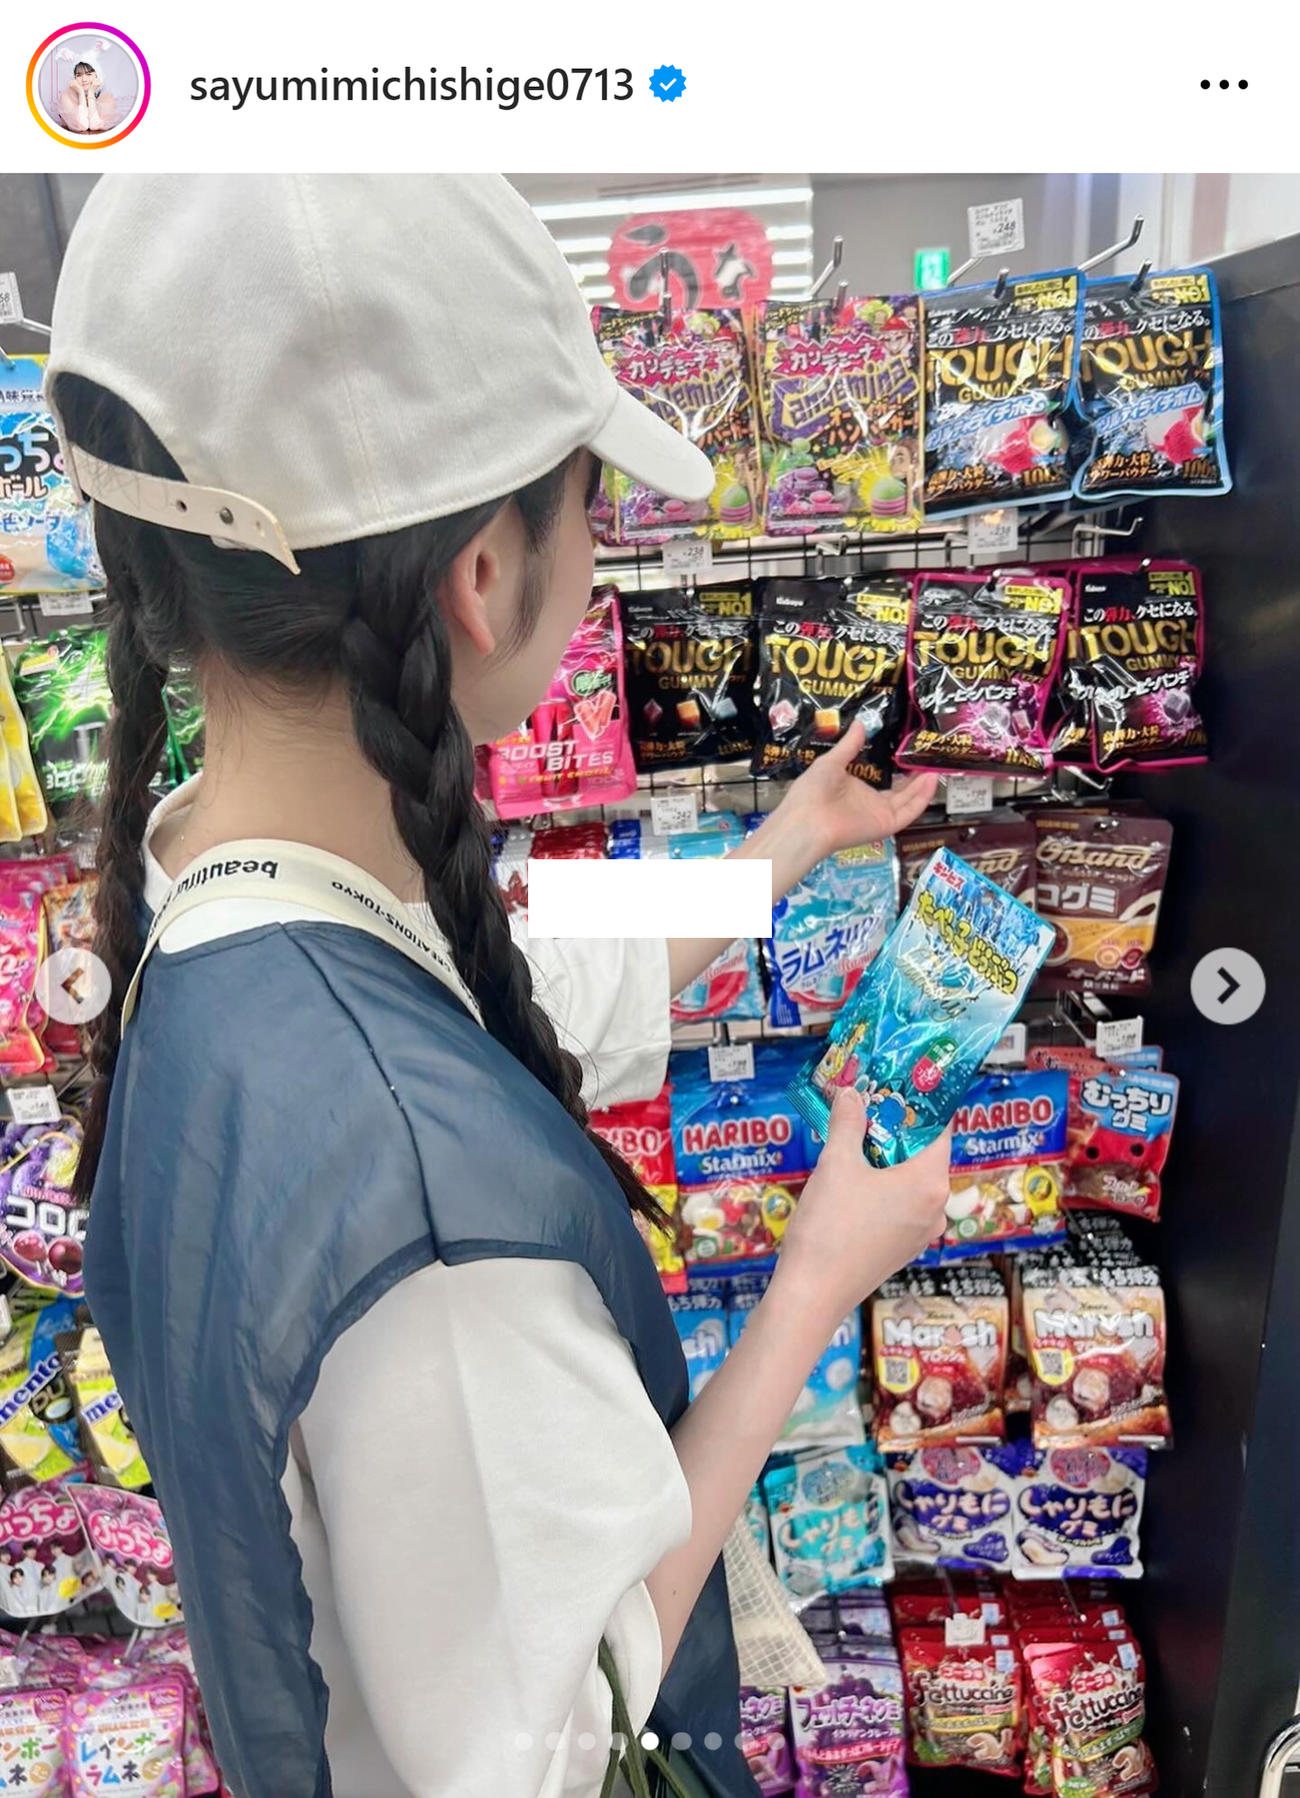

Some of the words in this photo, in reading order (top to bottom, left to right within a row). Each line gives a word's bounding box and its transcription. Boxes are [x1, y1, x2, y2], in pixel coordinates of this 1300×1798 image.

[1081, 329, 1213, 382] TOUGH
[764, 633, 906, 684] TOUGH
[914, 630, 1056, 677] TOUGH
[1081, 620, 1197, 662] TOUGH
[799, 678, 865, 698] GUMMY
[1037, 882, 1116, 913] コグミ
[917, 889, 1019, 995] たべっ子どうぶつ
[952, 1095, 1054, 1135] HARIBO
[1082, 1079, 1172, 1116] むっちり
[683, 1114, 792, 1155] HARIBO
[1112, 1110, 1148, 1133] グミ
[966, 1130, 1040, 1157] Starmix
[0, 1354, 63, 1428] ento
[1018, 1487, 1137, 1521] しゃりもに
[93, 1513, 170, 1562] ぷっちょ
[1060, 1520, 1100, 1538] グミ
[86, 1760, 141, 1787] ラムネ
